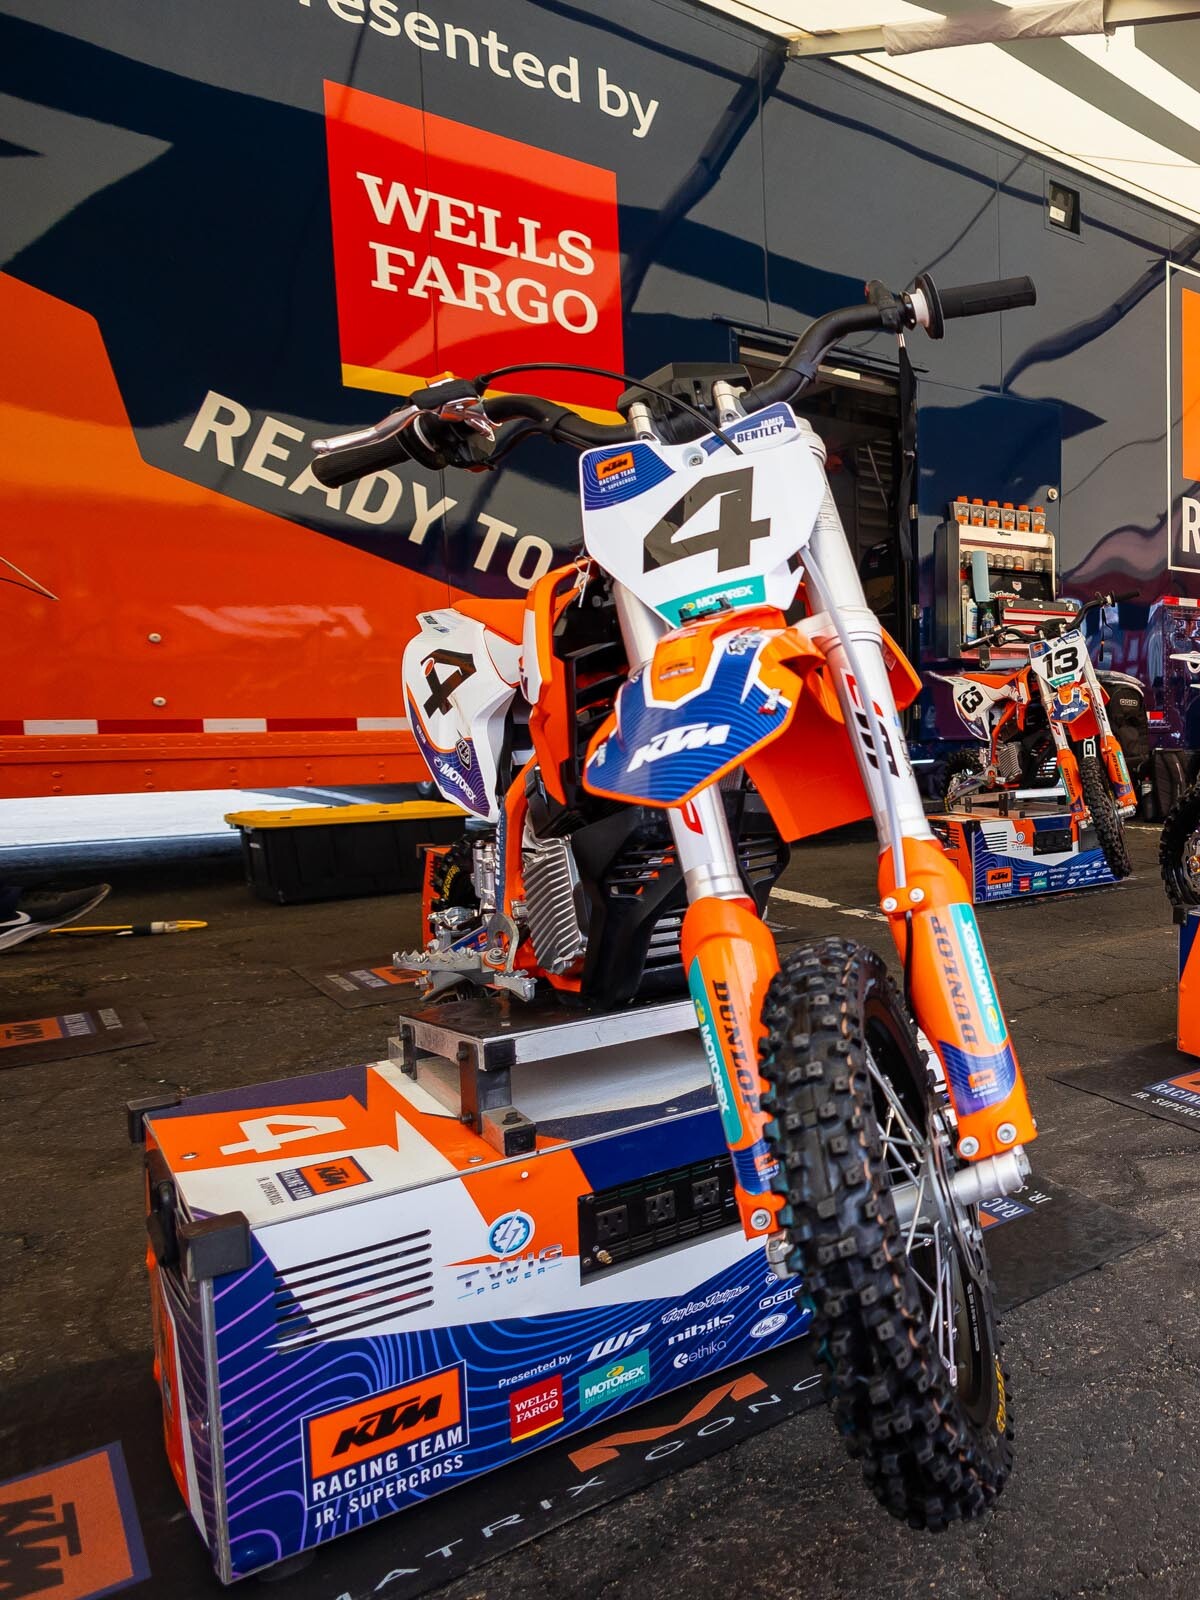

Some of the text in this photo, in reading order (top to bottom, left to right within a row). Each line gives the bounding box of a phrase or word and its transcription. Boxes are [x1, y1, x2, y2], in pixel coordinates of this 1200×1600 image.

[297, 0, 659, 138] esented by
[356, 171, 595, 276] WELLS
[369, 241, 598, 334] FARGO
[737, 423, 783, 443] BENTLEY
[598, 468, 636, 486] RACING TEAM
[643, 466, 771, 574] 4
[473, 513, 554, 590] TO
[695, 584, 753, 610] MOTOREX
[1042, 646, 1078, 679] 13
[420, 649, 477, 719] 4
[627, 723, 731, 772] KTM
[439, 763, 476, 805] MOTOREX
[991, 872, 1008, 881] KTM
[931, 916, 978, 1046] DUNLOP
[961, 918, 995, 1008] MOTOREX
[712, 979, 763, 1113] DUNLOP
[701, 1024, 729, 1114] MOTOREX
[1131, 1091, 1147, 1101] JR.
[219, 1114, 347, 1156] 4
[314, 1166, 350, 1186] KTM
[1028, 1190, 1053, 1204] JR.
[456, 1243, 563, 1289] TWIG
[476, 1267, 545, 1295] POWER
[587, 1323, 652, 1362] WP
[668, 1314, 735, 1346] nihilo
[689, 1339, 727, 1362] ethika
[498, 1353, 573, 1389] Presented by
[585, 1364, 647, 1399] MOTOREX
[514, 1388, 558, 1413] WELLS
[515, 1399, 559, 1424] FARGO
[331, 1393, 443, 1457] KTM
[312, 1426, 463, 1501] RACING TEAM
[314, 1454, 463, 1528] JR. SUPERCROSS
